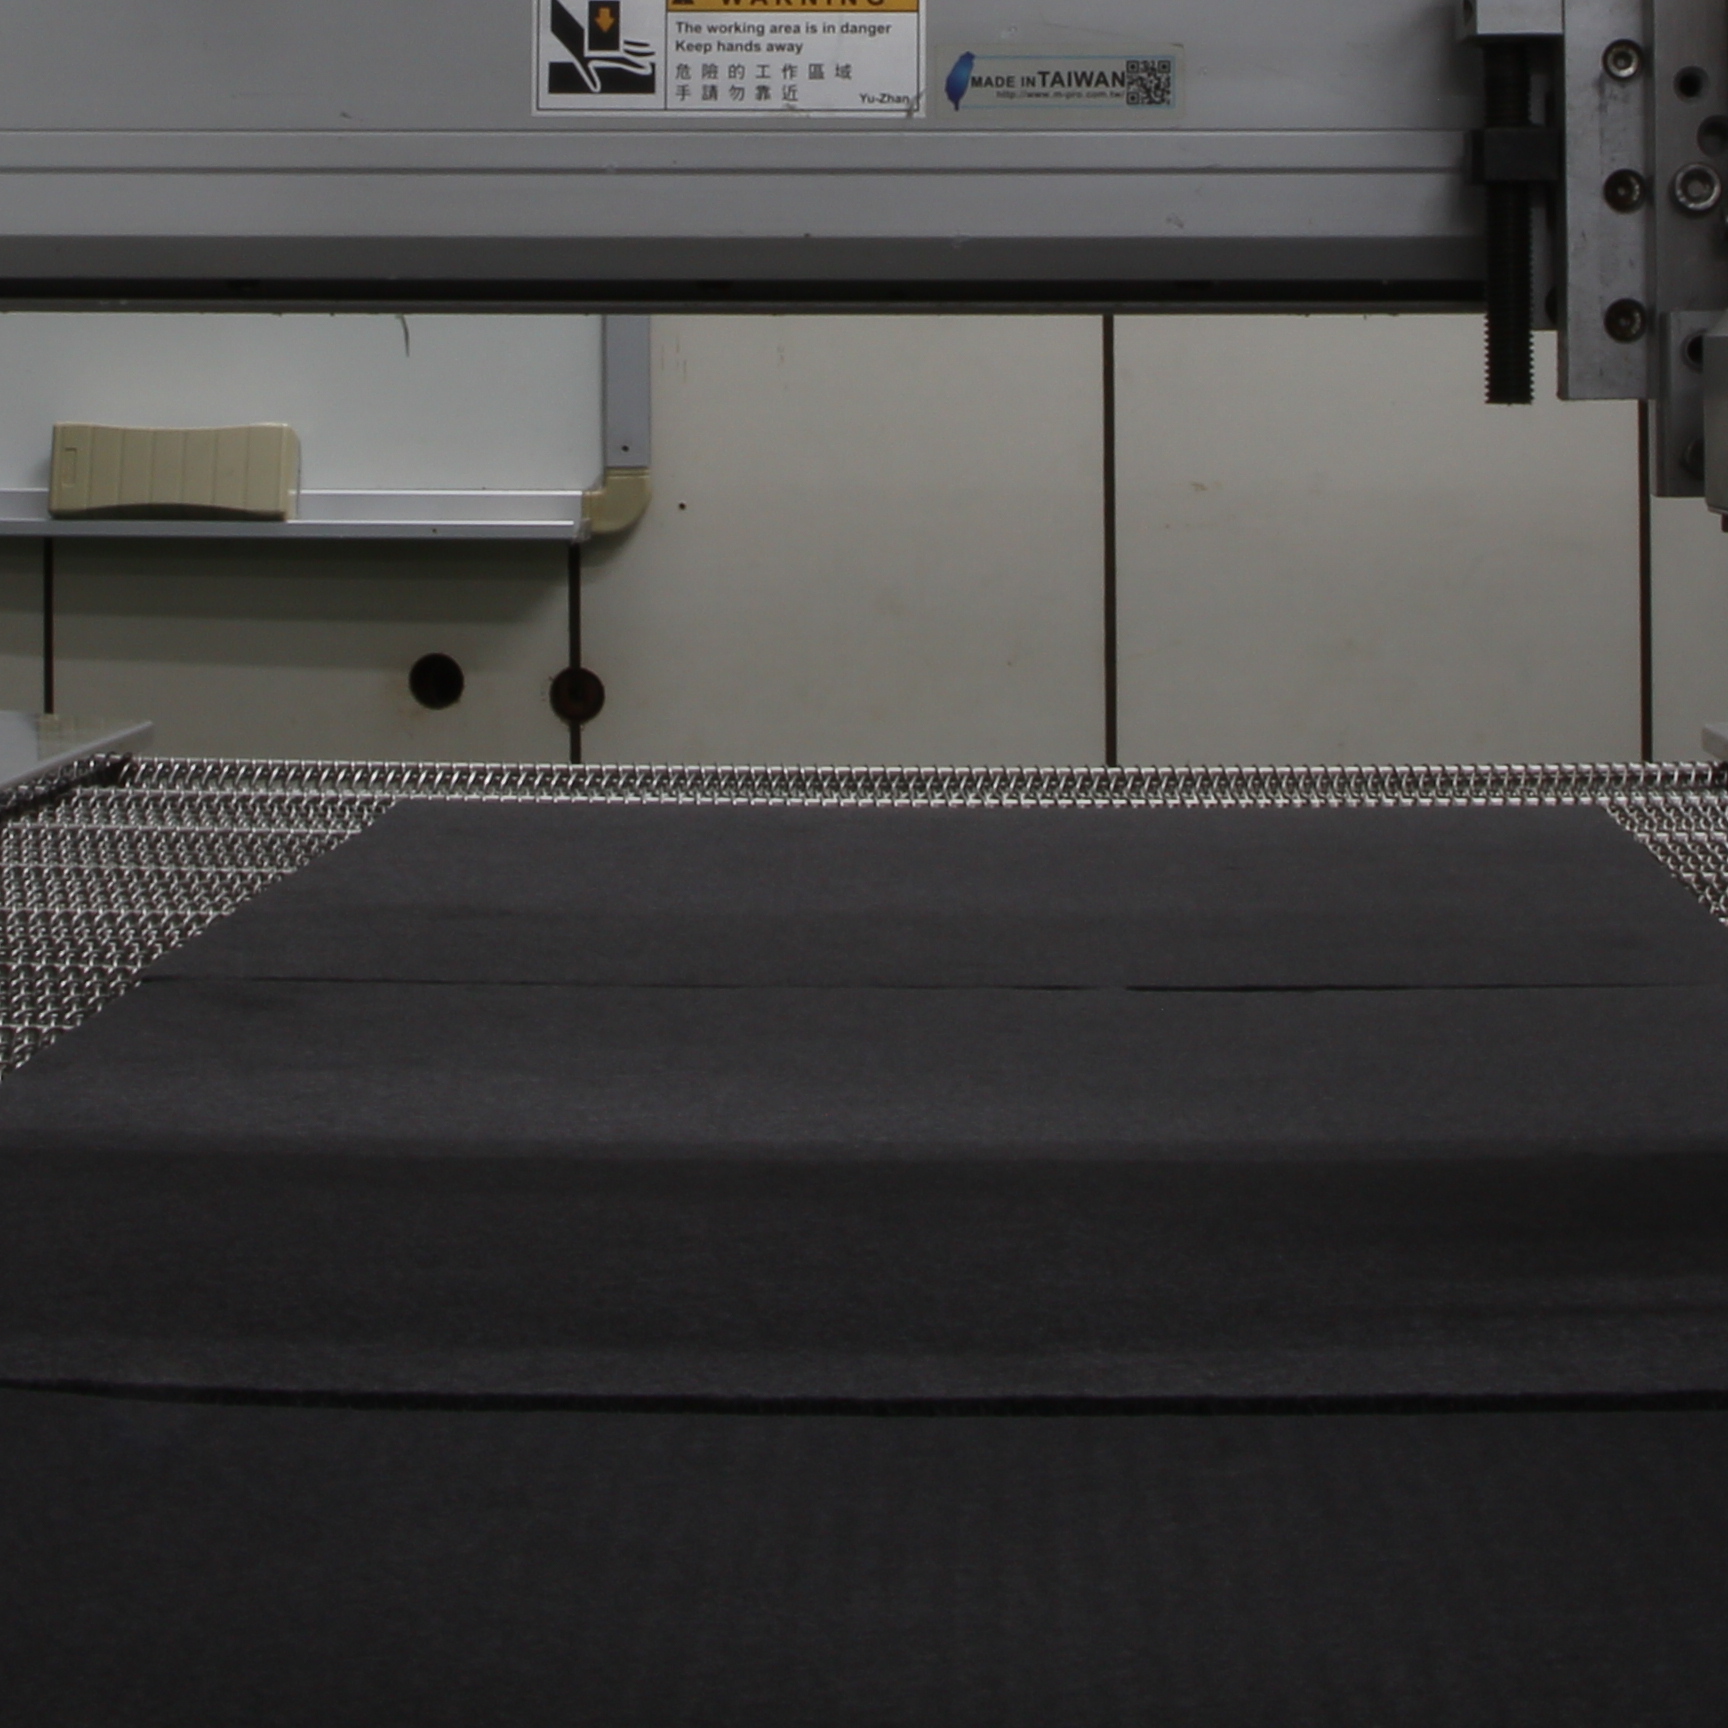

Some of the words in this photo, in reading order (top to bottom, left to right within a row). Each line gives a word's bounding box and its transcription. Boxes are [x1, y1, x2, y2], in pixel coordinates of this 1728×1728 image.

[675, 22, 702, 34] The
[706, 22, 765, 37] working
[769, 24, 802, 34] area
[805, 22, 819, 34] is
[822, 22, 836, 34] in
[840, 22, 893, 37] danger
[675, 41, 713, 55] Keep
[717, 41, 762, 52] hands
[766, 43, 804, 55] away
[971, 76, 1015, 88] MADE
[1021, 76, 1036, 87] IN
[1038, 71, 1126, 89] TAIWAN
